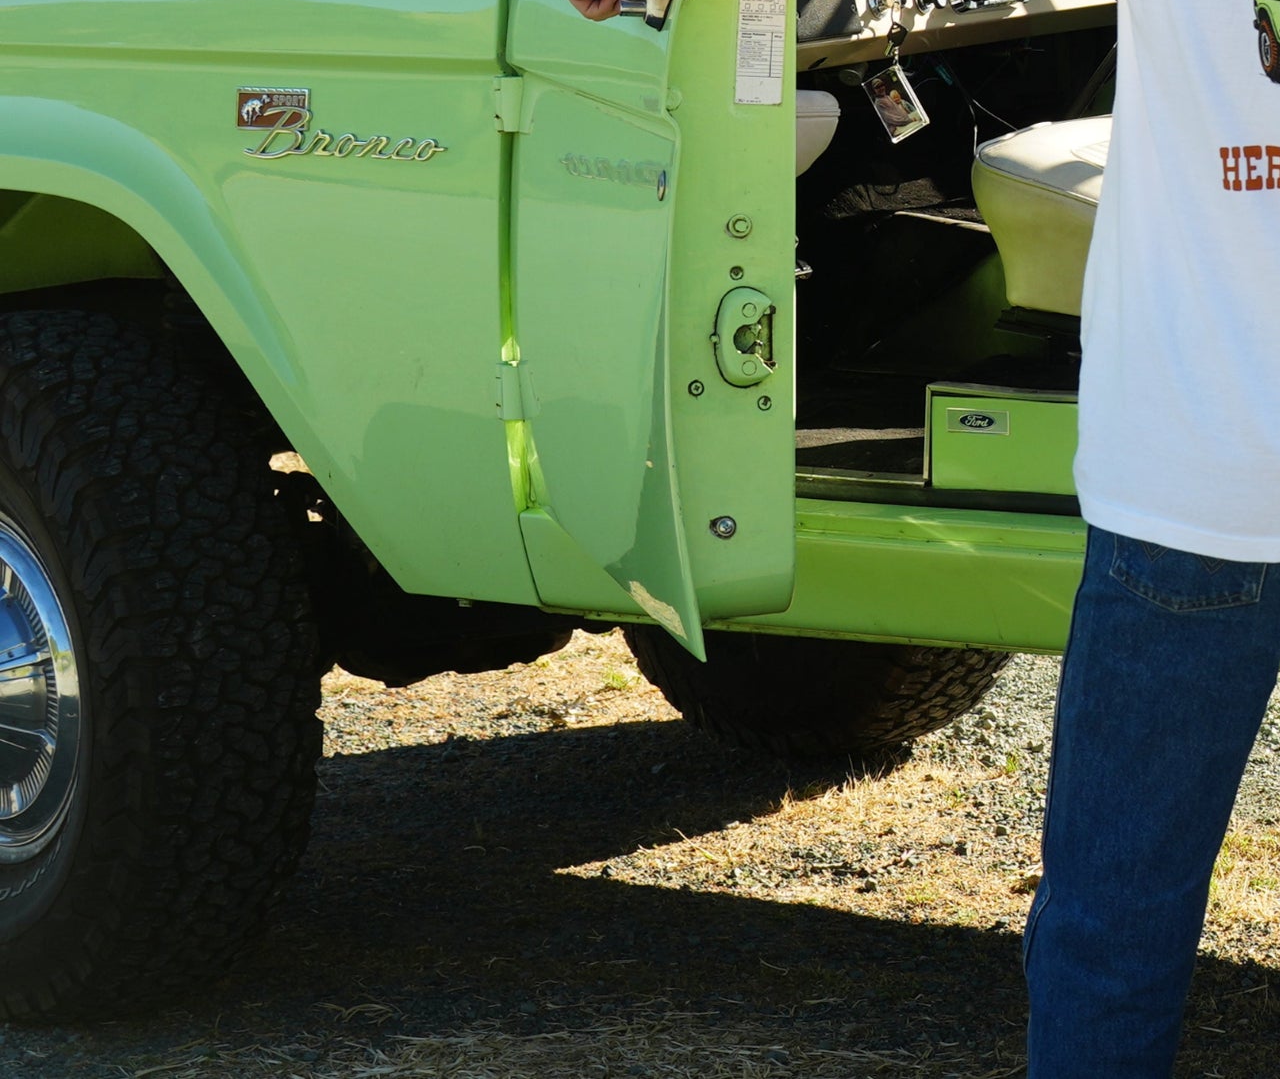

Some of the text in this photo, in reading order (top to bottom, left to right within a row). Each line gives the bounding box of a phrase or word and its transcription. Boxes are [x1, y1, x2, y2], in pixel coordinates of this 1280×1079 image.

[272, 94, 305, 107] SPORT
[244, 106, 448, 162] Bronco
[964, 414, 989, 427] Ford
